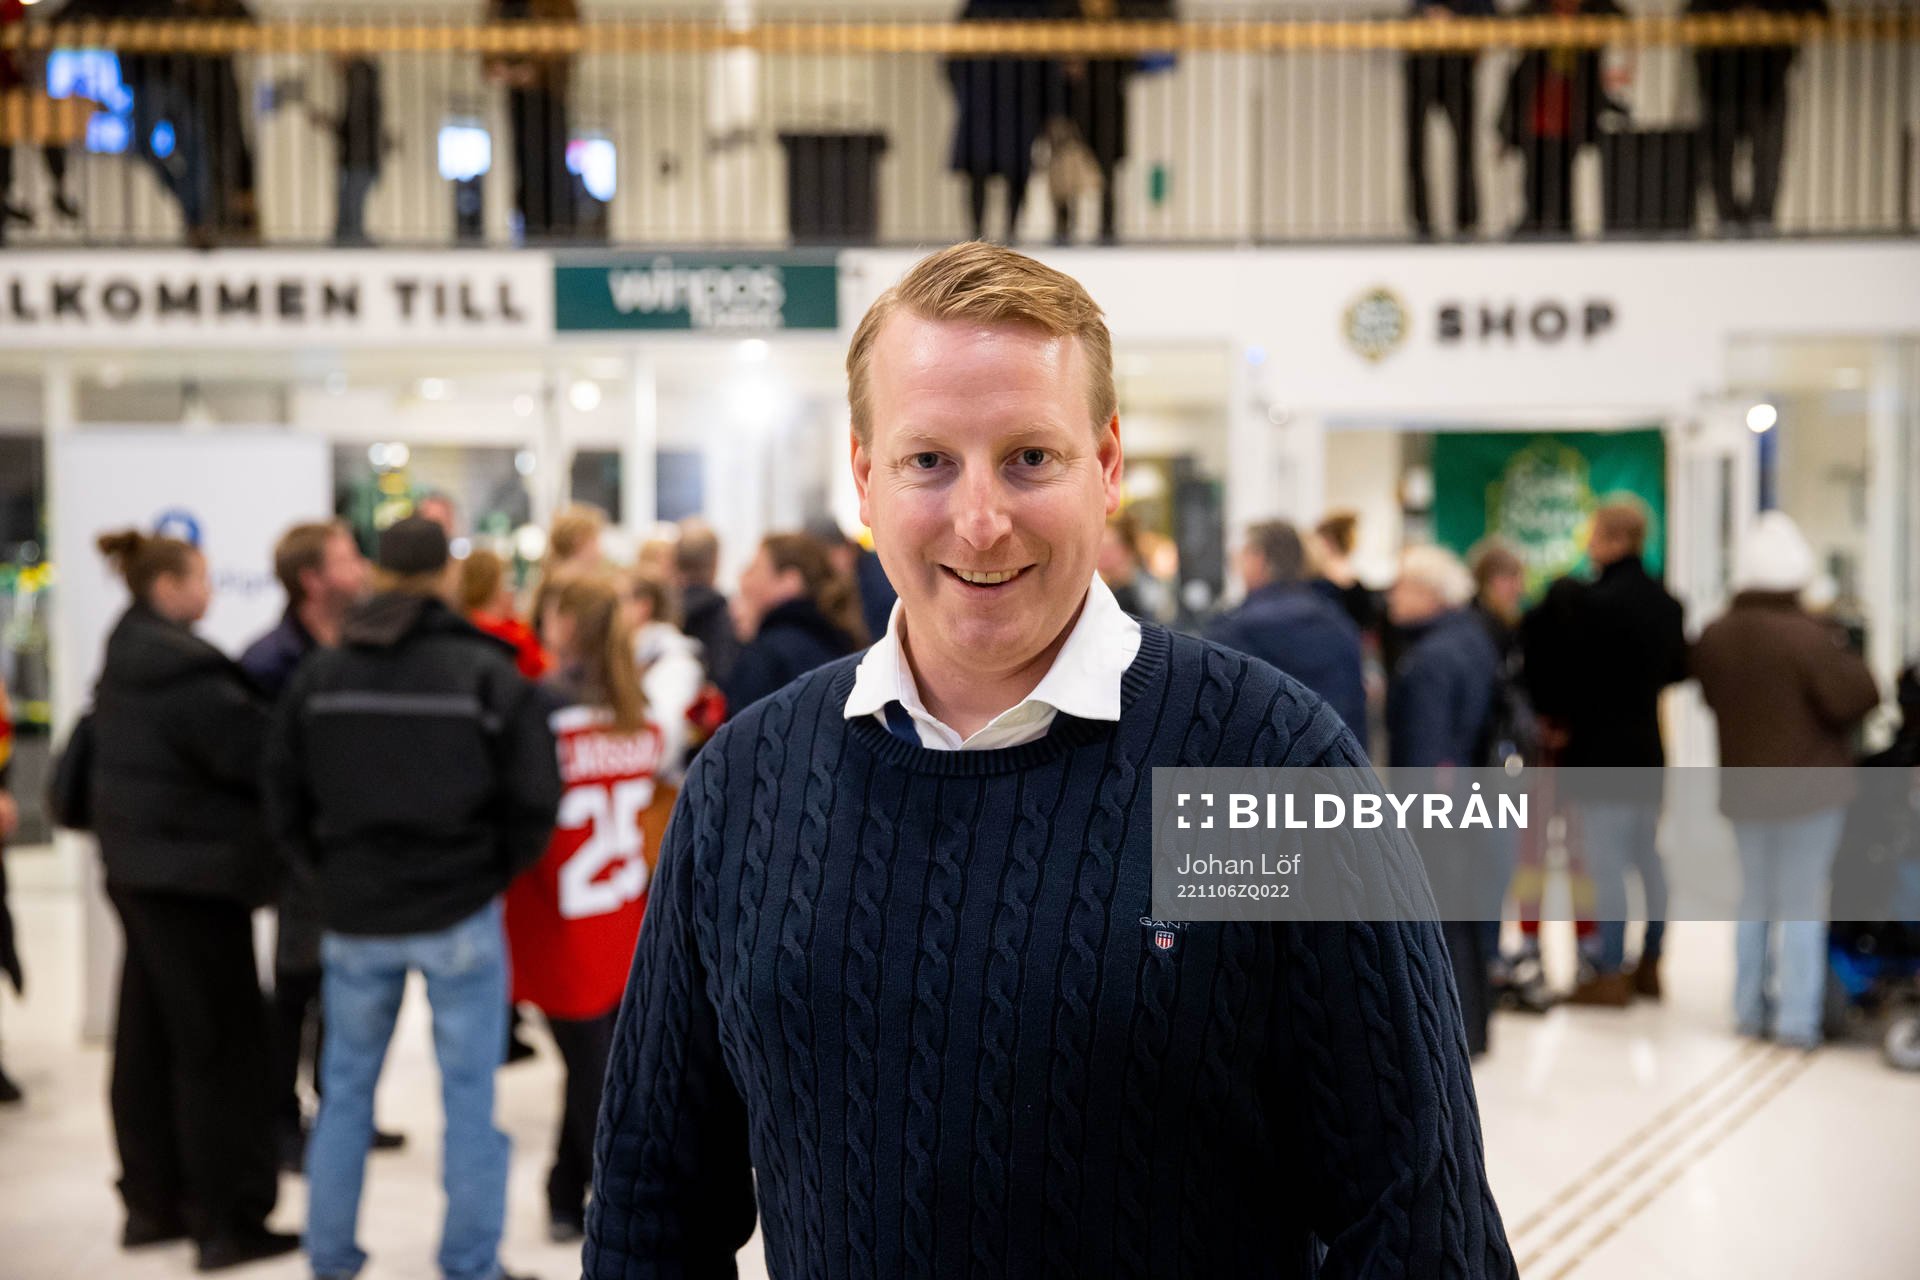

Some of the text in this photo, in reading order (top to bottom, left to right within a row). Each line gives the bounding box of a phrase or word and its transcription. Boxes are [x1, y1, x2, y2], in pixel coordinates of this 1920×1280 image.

[5, 277, 525, 323] LKOMMEN TILL
[1435, 301, 1618, 344] SHOP
[557, 779, 654, 919] 25
[1139, 916, 1191, 930] GANT
